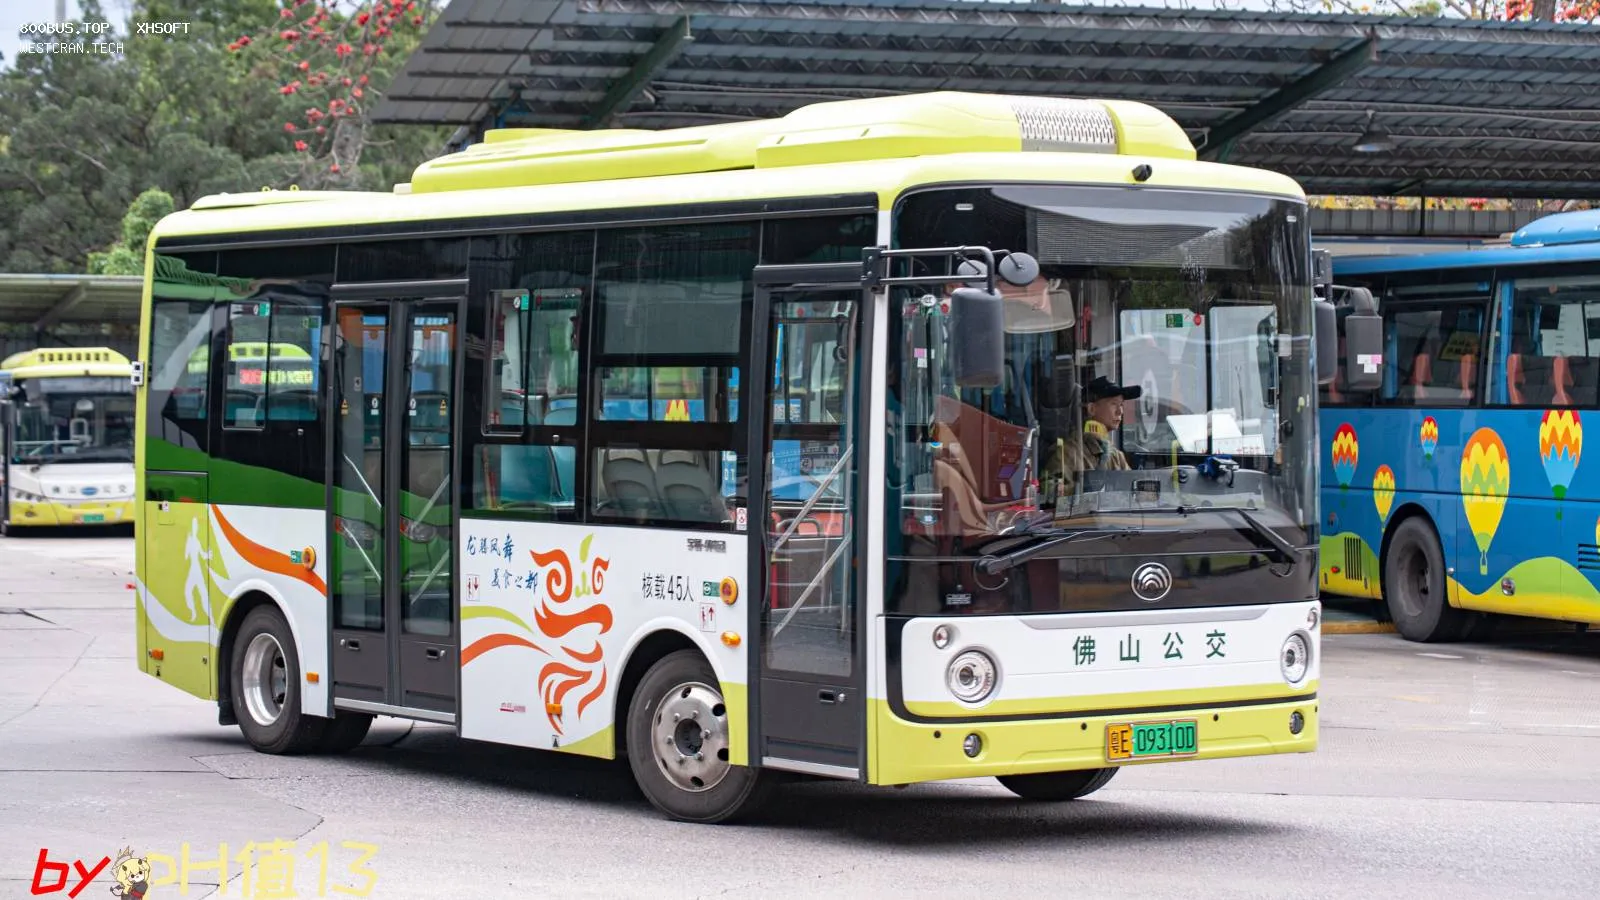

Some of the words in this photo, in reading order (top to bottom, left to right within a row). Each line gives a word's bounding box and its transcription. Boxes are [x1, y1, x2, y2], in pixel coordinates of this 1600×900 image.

[642, 572, 694, 602] 核载45人
[1072, 629, 1226, 666] 佛山公交
